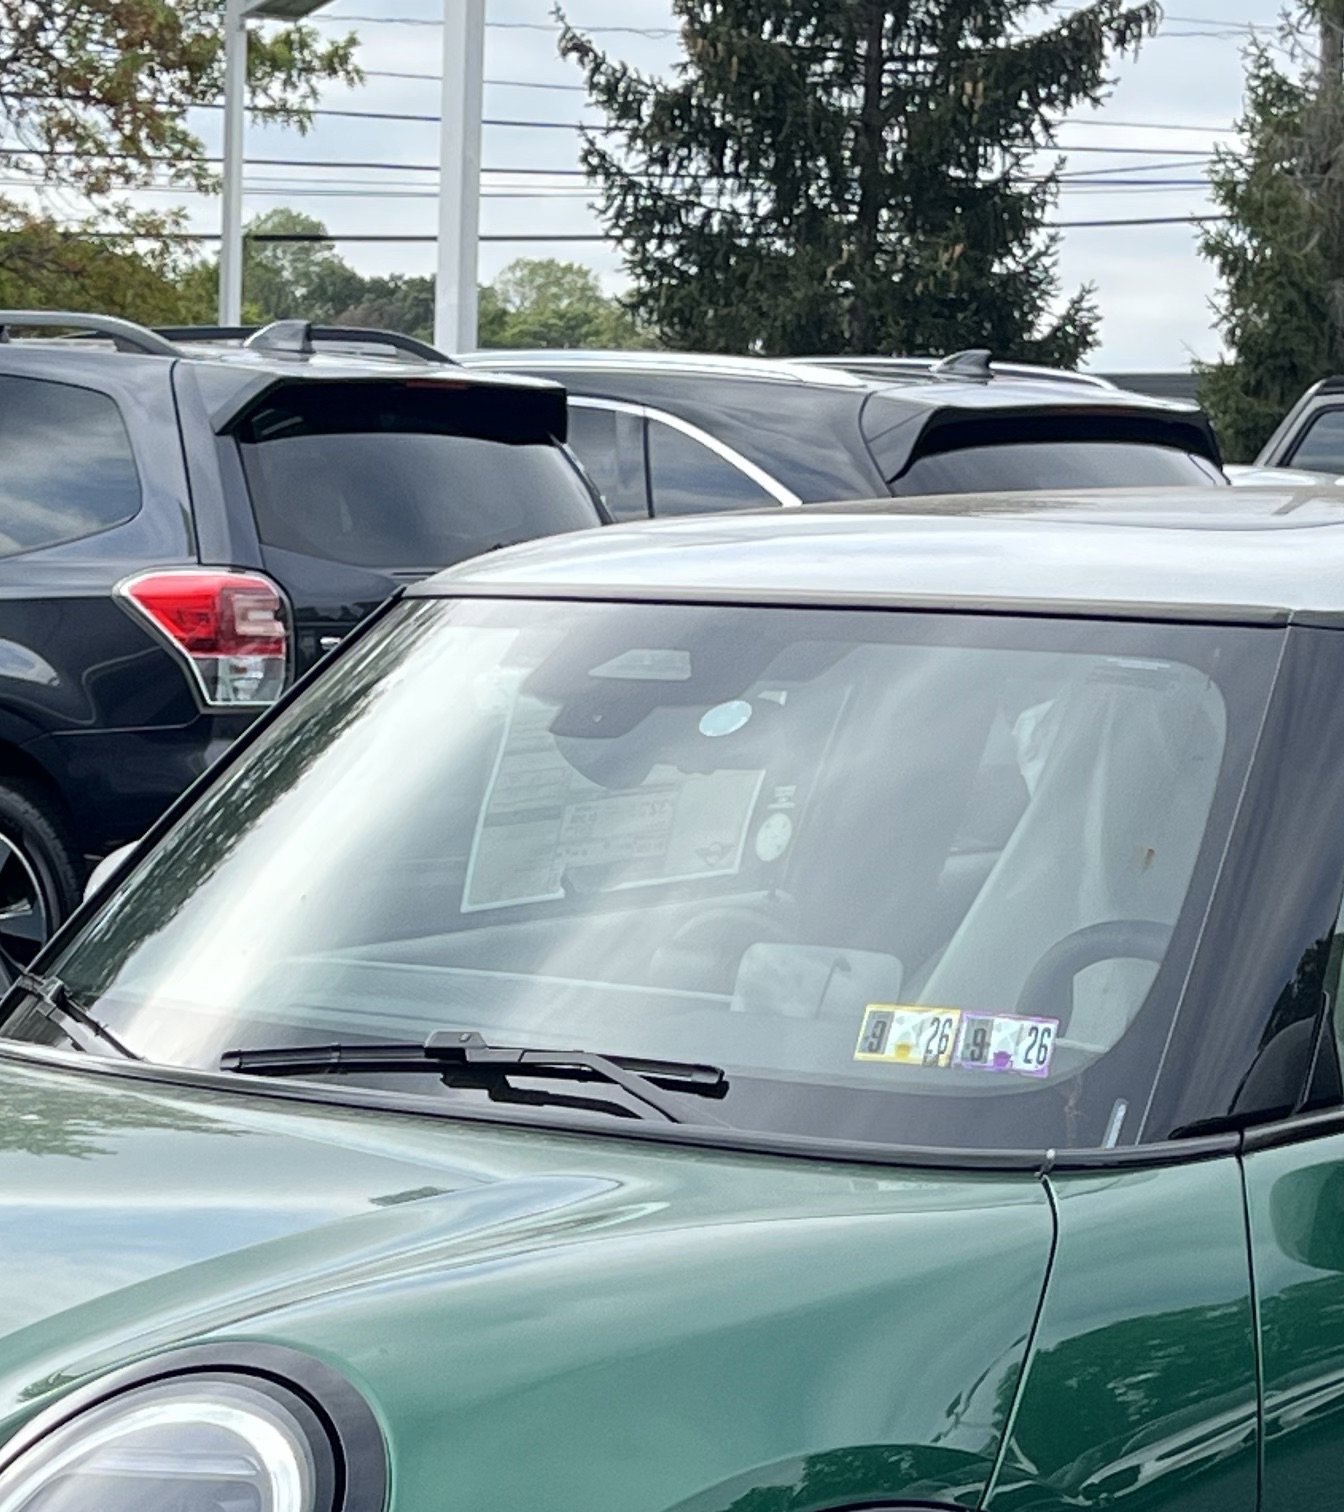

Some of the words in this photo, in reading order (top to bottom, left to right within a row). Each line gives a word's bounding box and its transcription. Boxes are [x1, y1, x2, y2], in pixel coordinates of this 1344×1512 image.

[867, 1020, 888, 1054] 9
[924, 1016, 953, 1056] 26
[969, 1027, 988, 1062] 9
[1022, 1025, 1053, 1066] 26
